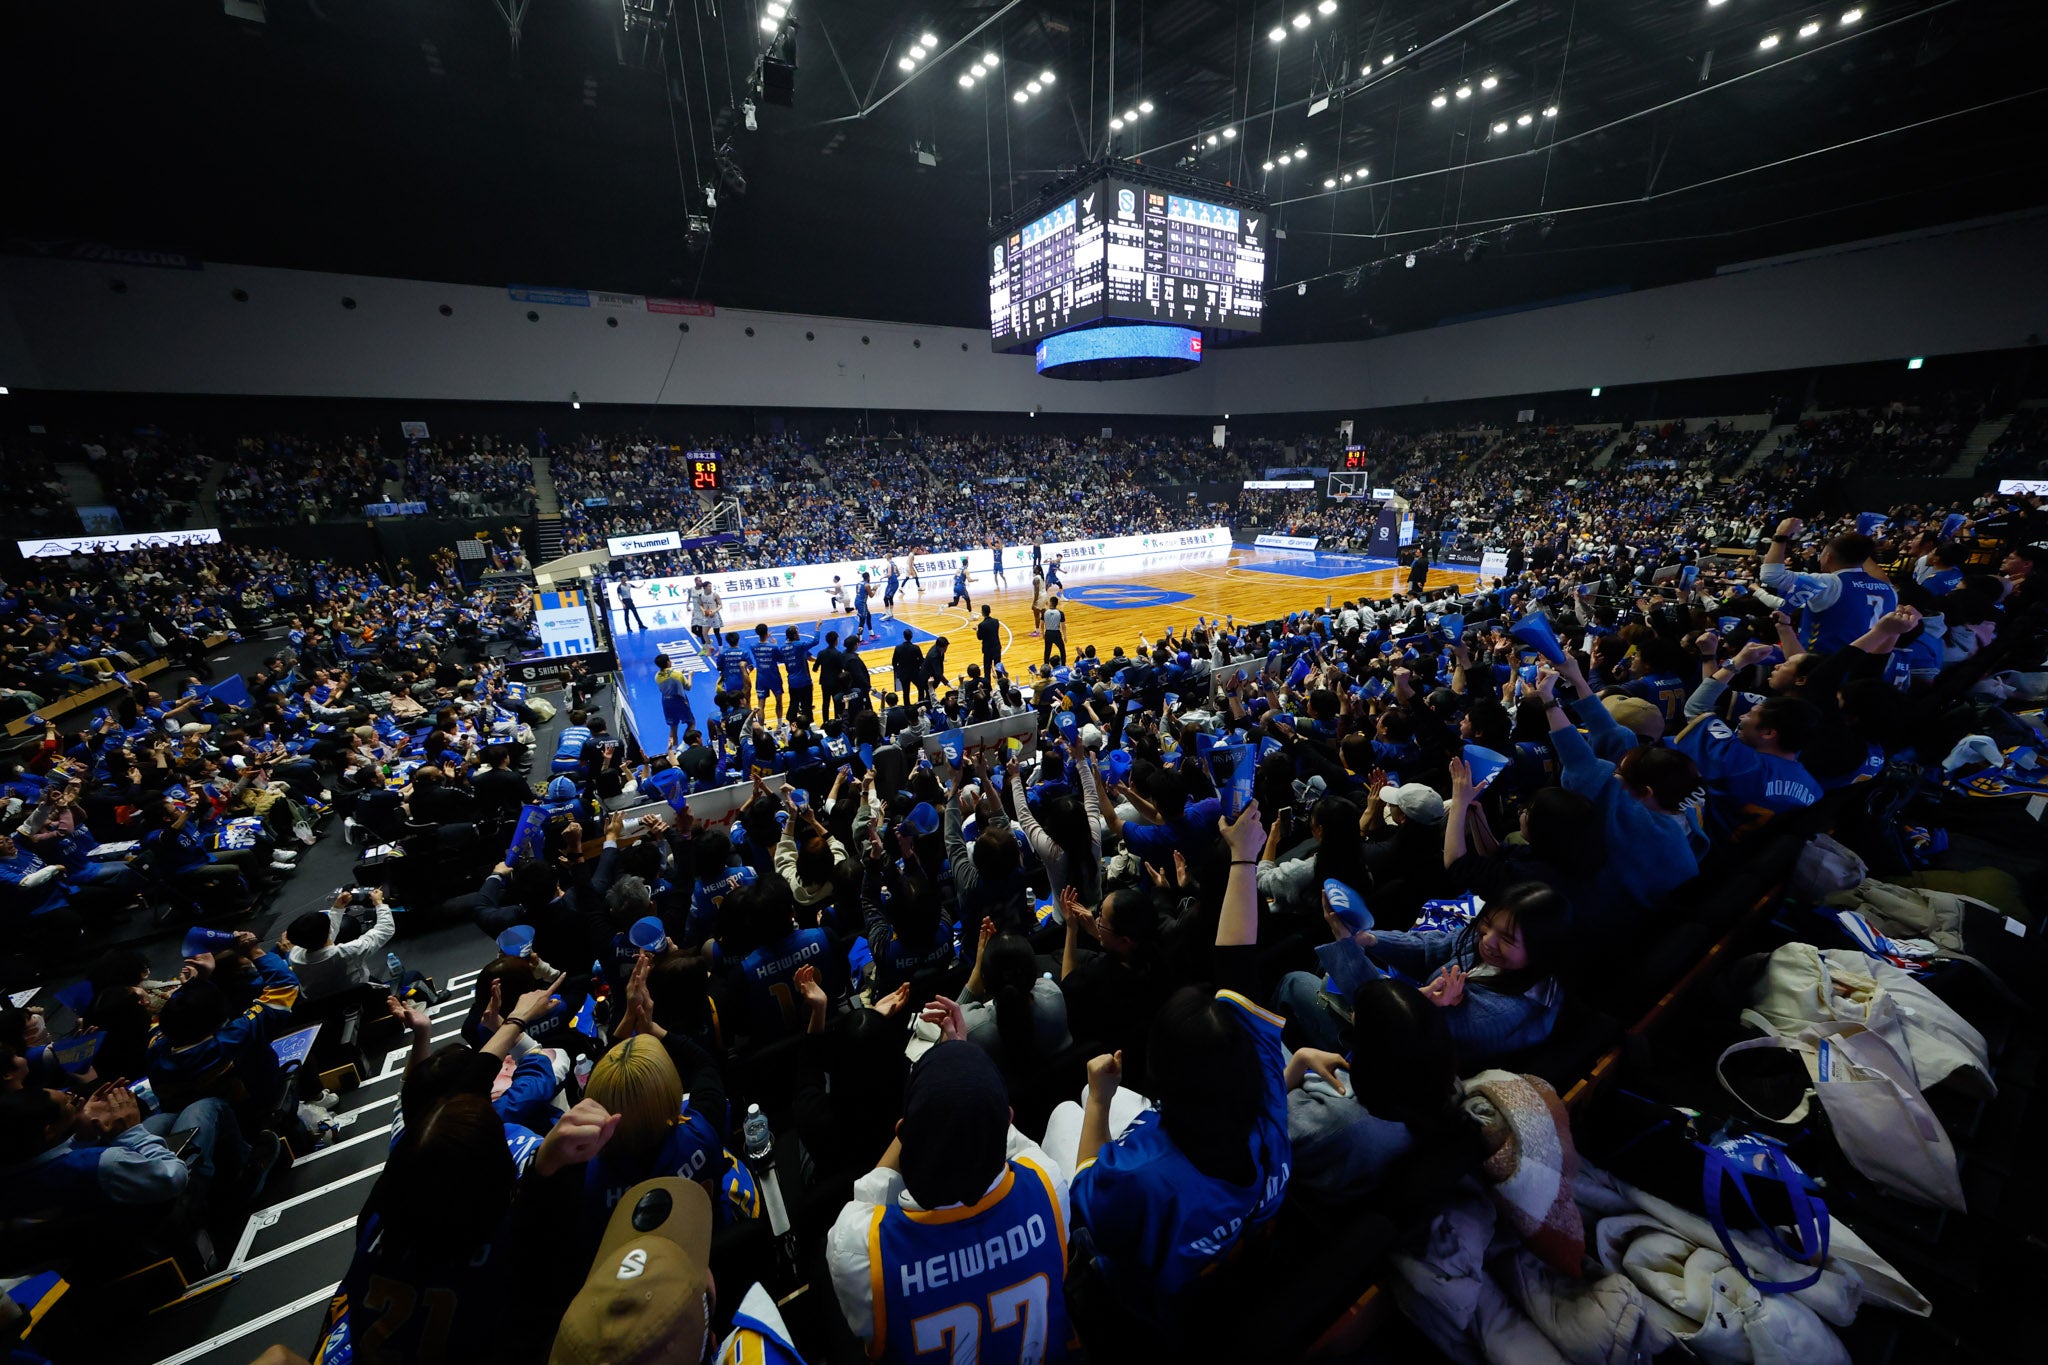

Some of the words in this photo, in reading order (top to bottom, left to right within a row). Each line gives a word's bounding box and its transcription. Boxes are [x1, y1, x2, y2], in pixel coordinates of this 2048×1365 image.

[695, 462, 717, 473] 8:13
[1346, 457, 1358, 467] 24
[694, 472, 716, 488] 24
[71, 539, 120, 551] フジケン
[633, 537, 670, 549] hummel
[914, 559, 958, 574] 吉勝重建
[724, 575, 782, 593] 吉勝重建
[1866, 594, 1885, 631] 7
[538, 665, 559, 676] SHIGA
[757, 942, 822, 980] HEIWADO
[901, 1214, 1046, 1297] HEIWADO
[911, 1272, 1050, 1365] 77
